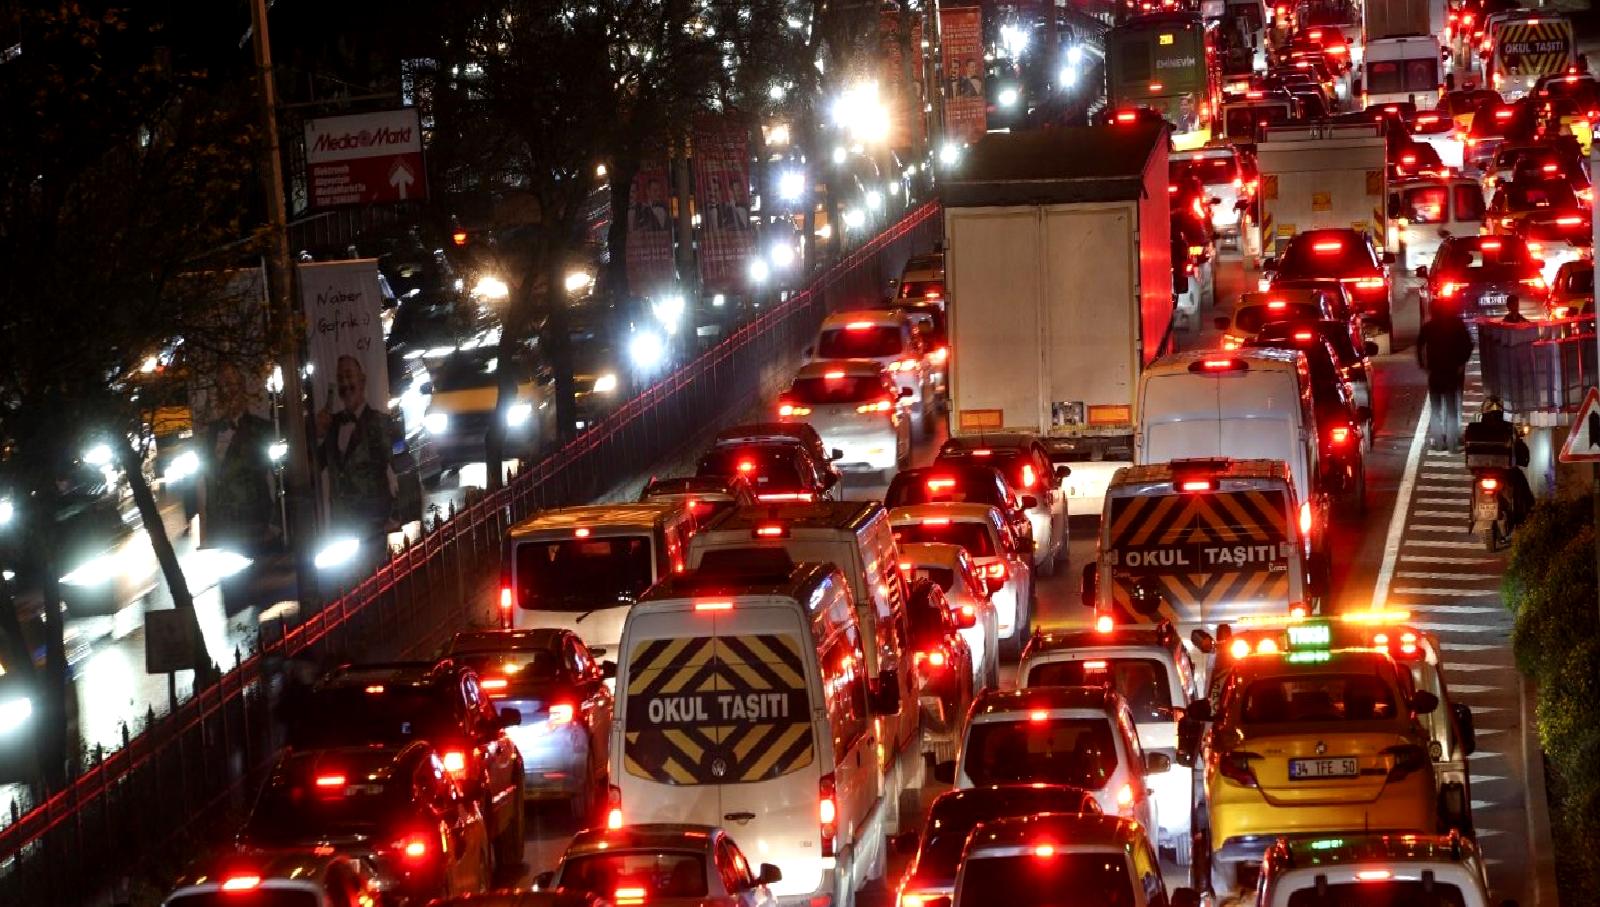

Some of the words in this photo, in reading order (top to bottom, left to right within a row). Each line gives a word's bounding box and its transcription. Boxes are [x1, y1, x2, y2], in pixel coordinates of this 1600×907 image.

[1505, 42, 1531, 53] OKUL
[1125, 548, 1190, 567] OKUL
[1204, 544, 1277, 567] TAŞITI
[648, 696, 708, 723] OKUL
[717, 693, 789, 722] TAŞITI
[1296, 761, 1308, 776] 34
[1316, 760, 1334, 775] TFE
